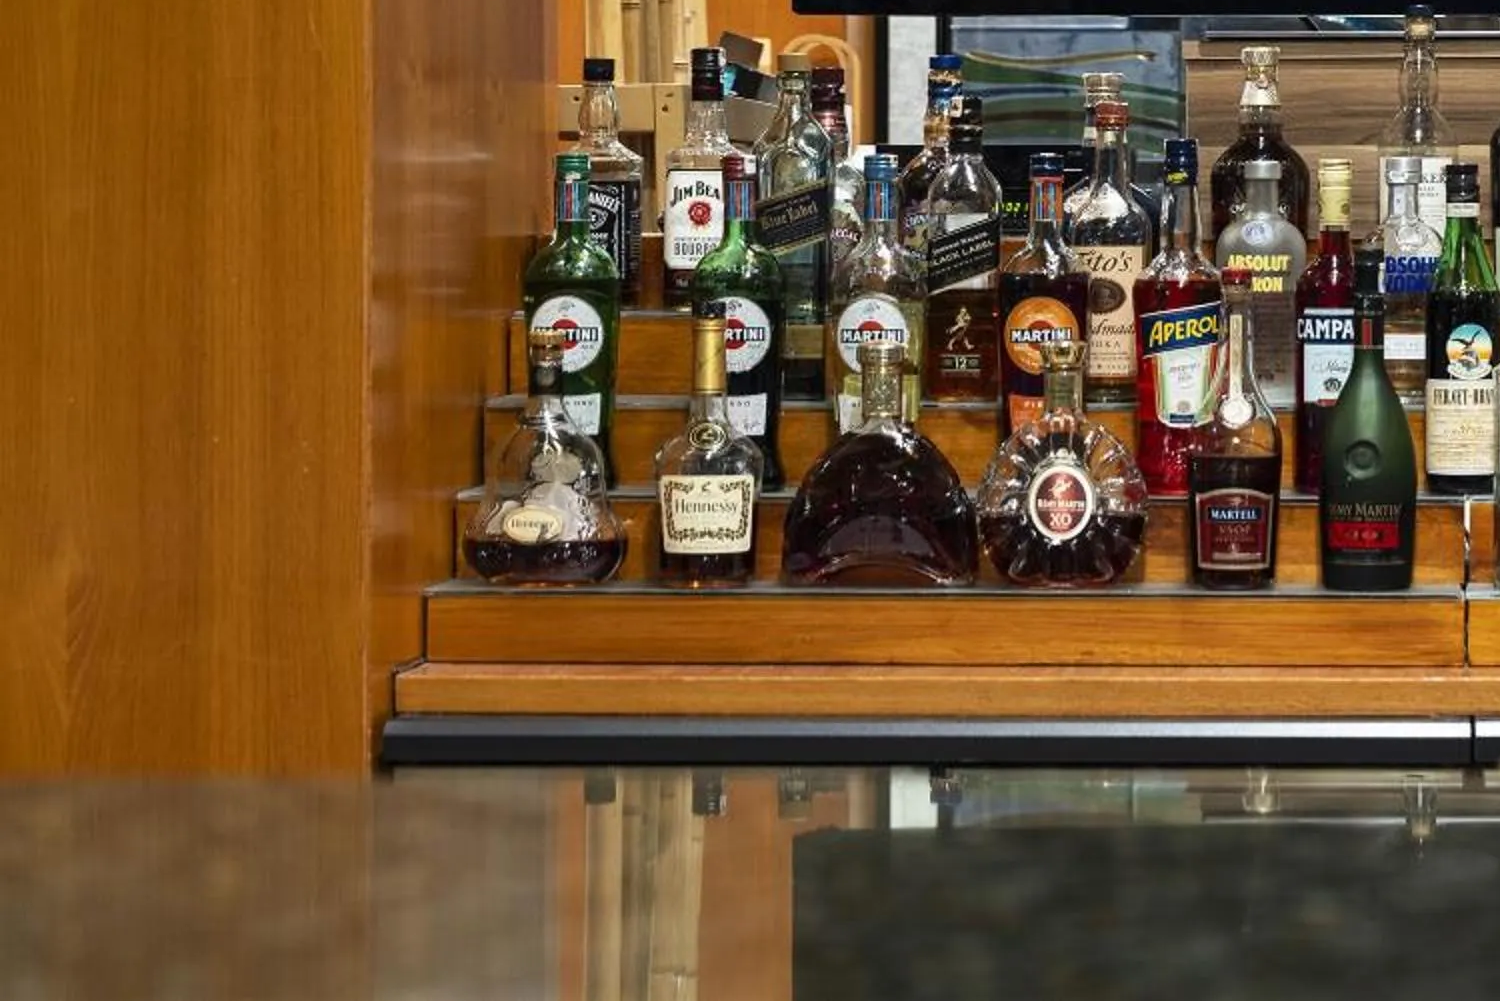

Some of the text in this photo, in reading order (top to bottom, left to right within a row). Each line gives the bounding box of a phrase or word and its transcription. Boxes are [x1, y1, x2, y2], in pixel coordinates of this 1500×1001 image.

[670, 185, 693, 207] JIM
[1228, 254, 1290, 272] ABSOLUT
[841, 329, 902, 342] MARTINI
[1011, 327, 1071, 342] MARTINI
[1149, 314, 1219, 348] APEROL
[675, 498, 738, 514] Hennessy
[1050, 512, 1072, 528] XO
[1211, 509, 1257, 520] MARTELL
